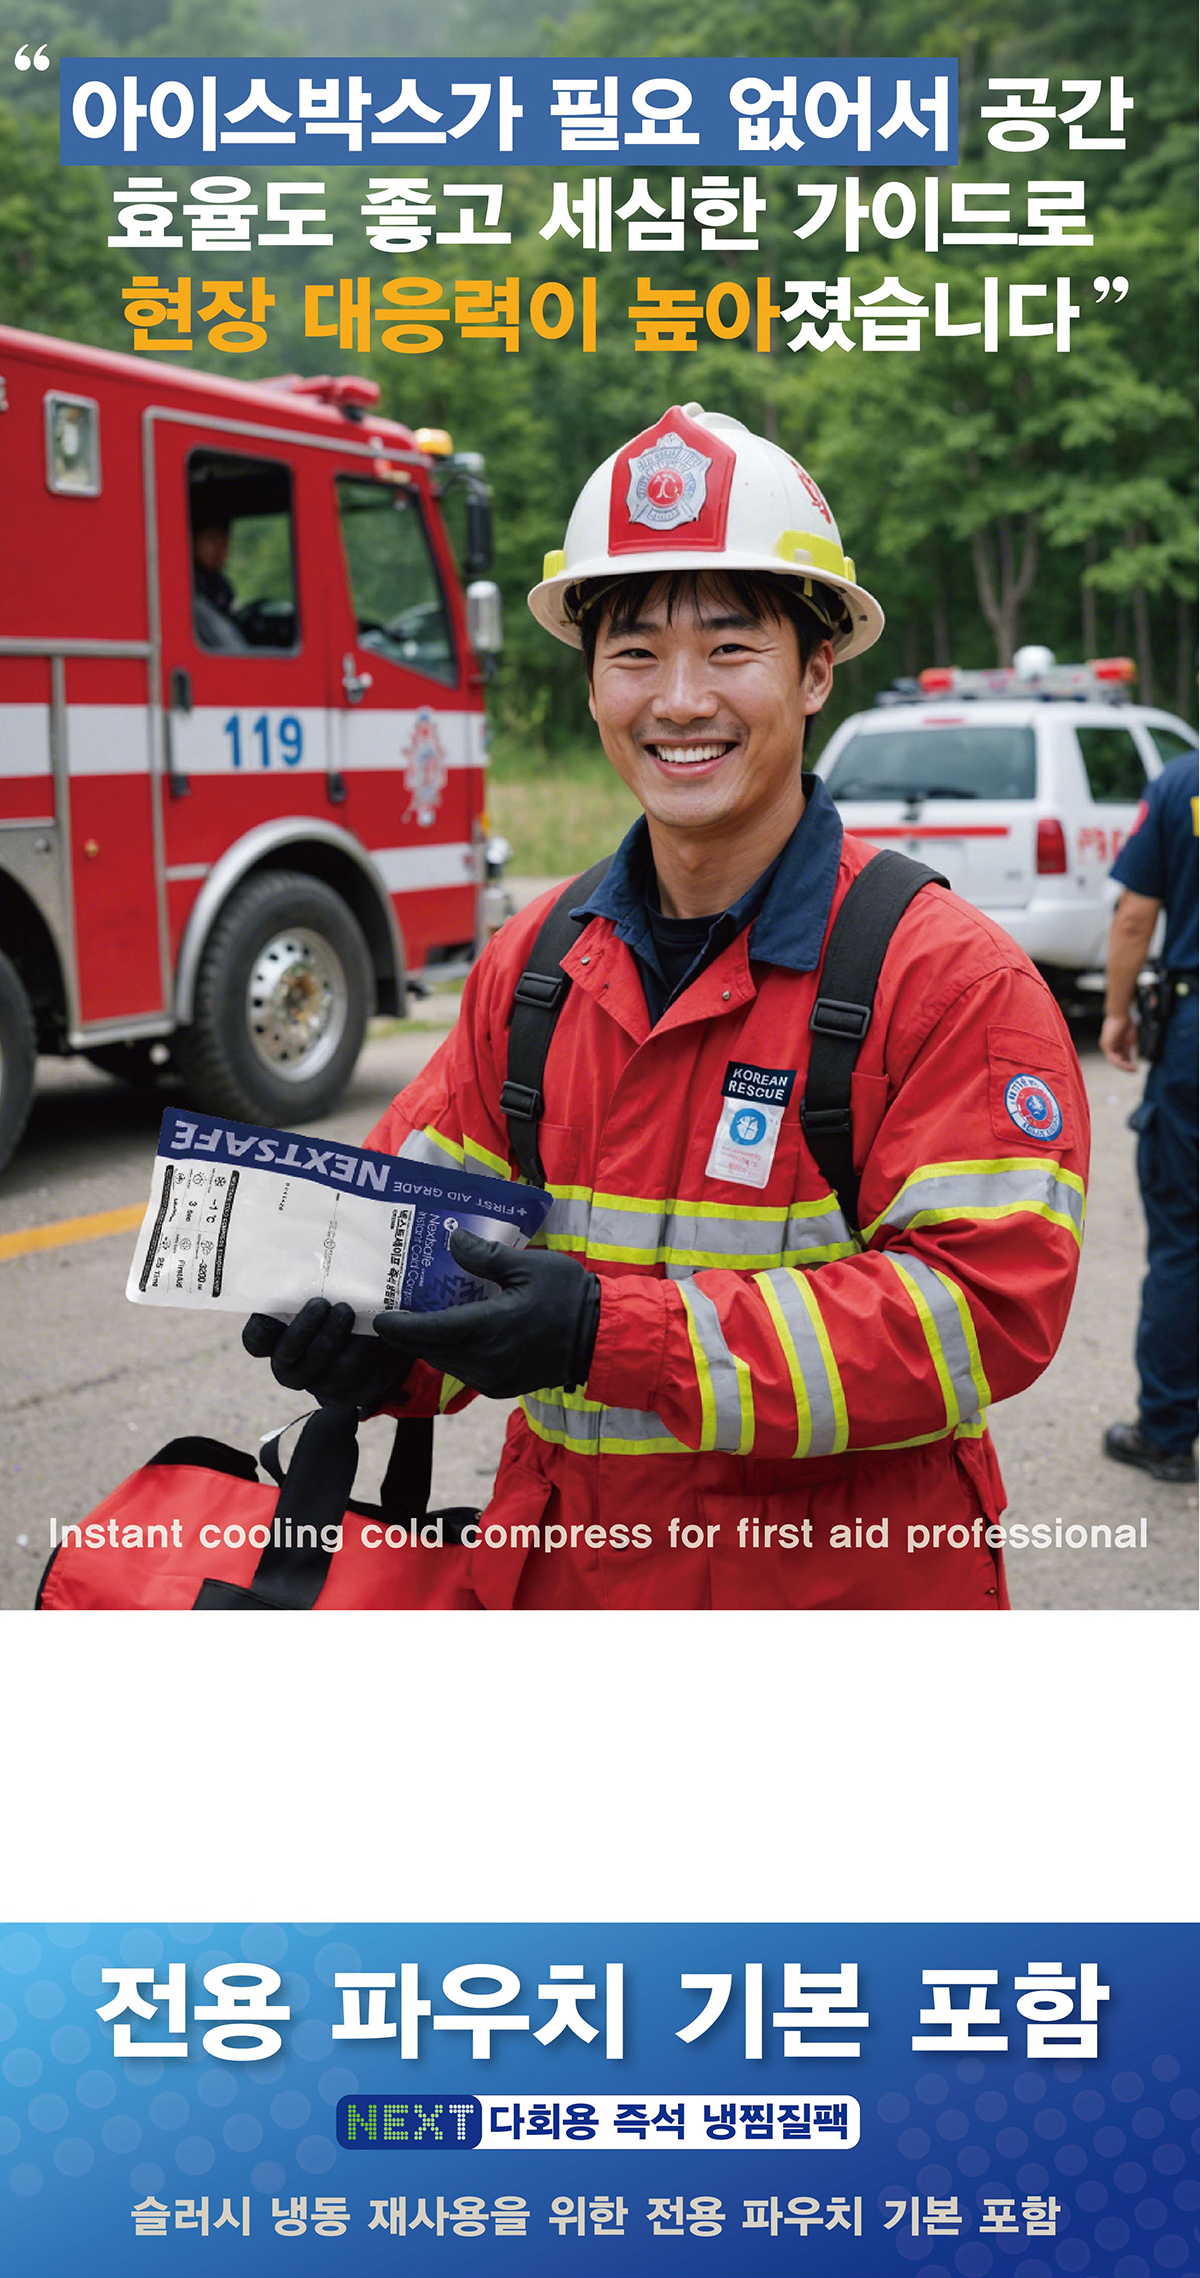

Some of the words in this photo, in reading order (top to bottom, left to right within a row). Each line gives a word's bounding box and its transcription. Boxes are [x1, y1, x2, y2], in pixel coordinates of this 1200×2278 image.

[224, 714, 304, 768] 119
[732, 1068, 789, 1087] KOREAN
[728, 1080, 785, 1101] RESCUE
[170, 1119, 391, 1192] NEXTSAFE
[393, 1181, 443, 1198] GRADE
[447, 1190, 472, 1203] AID
[476, 1196, 516, 1215] FIRST
[390, 1209, 409, 1265] 넥스트세이프
[421, 1213, 441, 1267] Nextsafe
